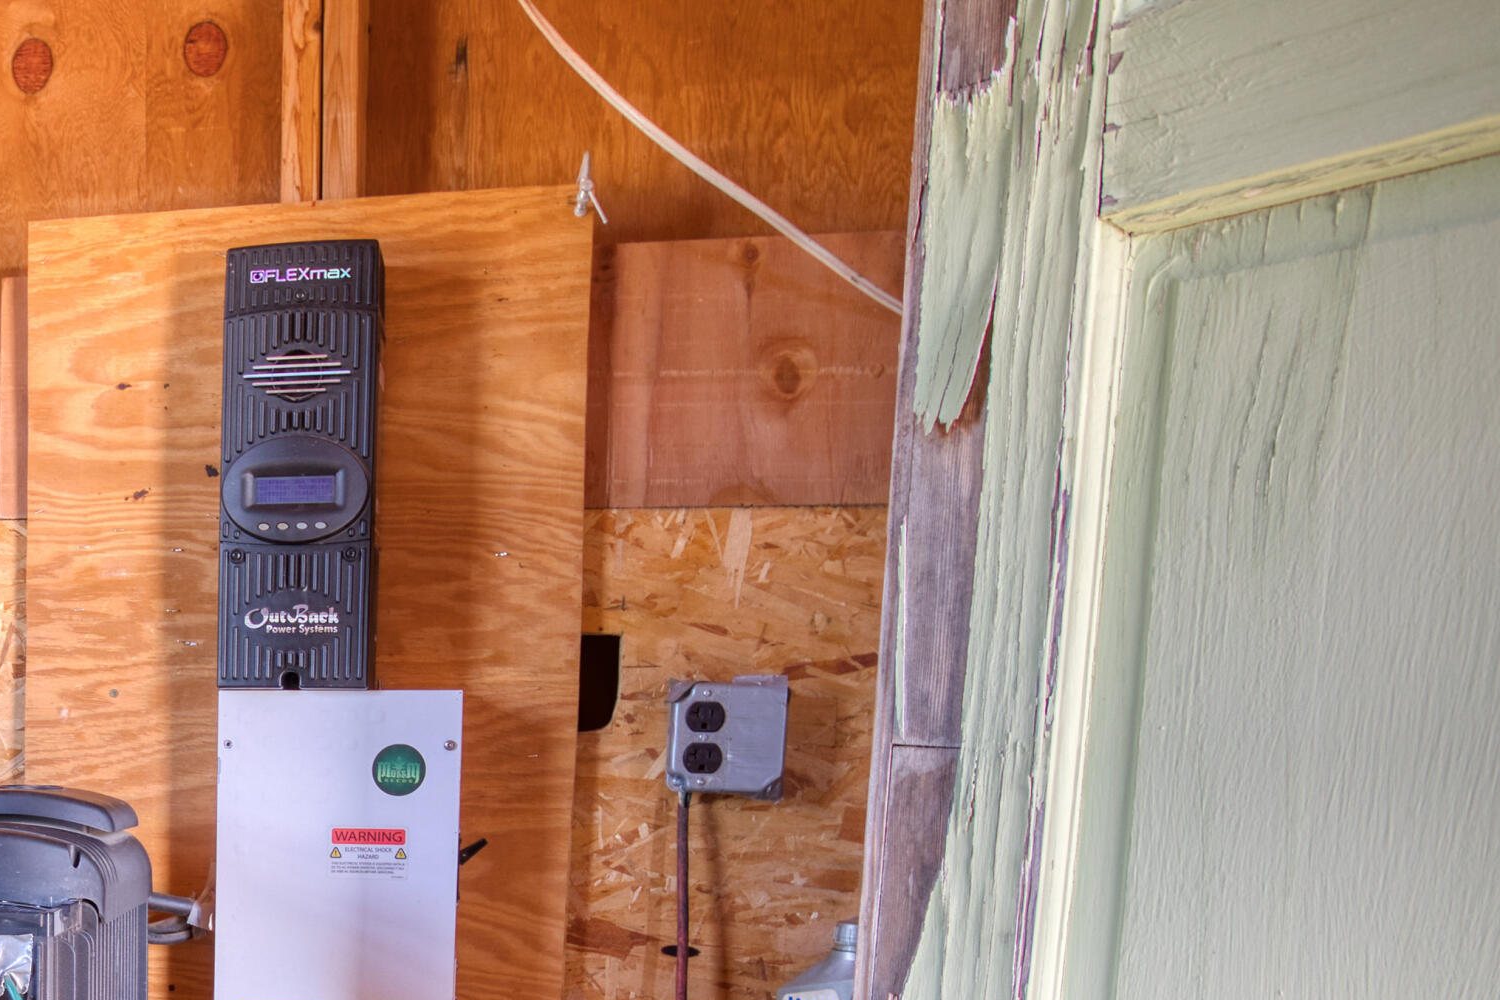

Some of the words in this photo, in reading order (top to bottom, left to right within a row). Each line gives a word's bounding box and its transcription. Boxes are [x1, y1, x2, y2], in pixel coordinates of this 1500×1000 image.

[265, 267, 351, 283] FLEXmax
[244, 603, 340, 630] OutBack
[266, 624, 296, 634] Power
[299, 624, 338, 636] Systems
[334, 831, 403, 842] WARNING
